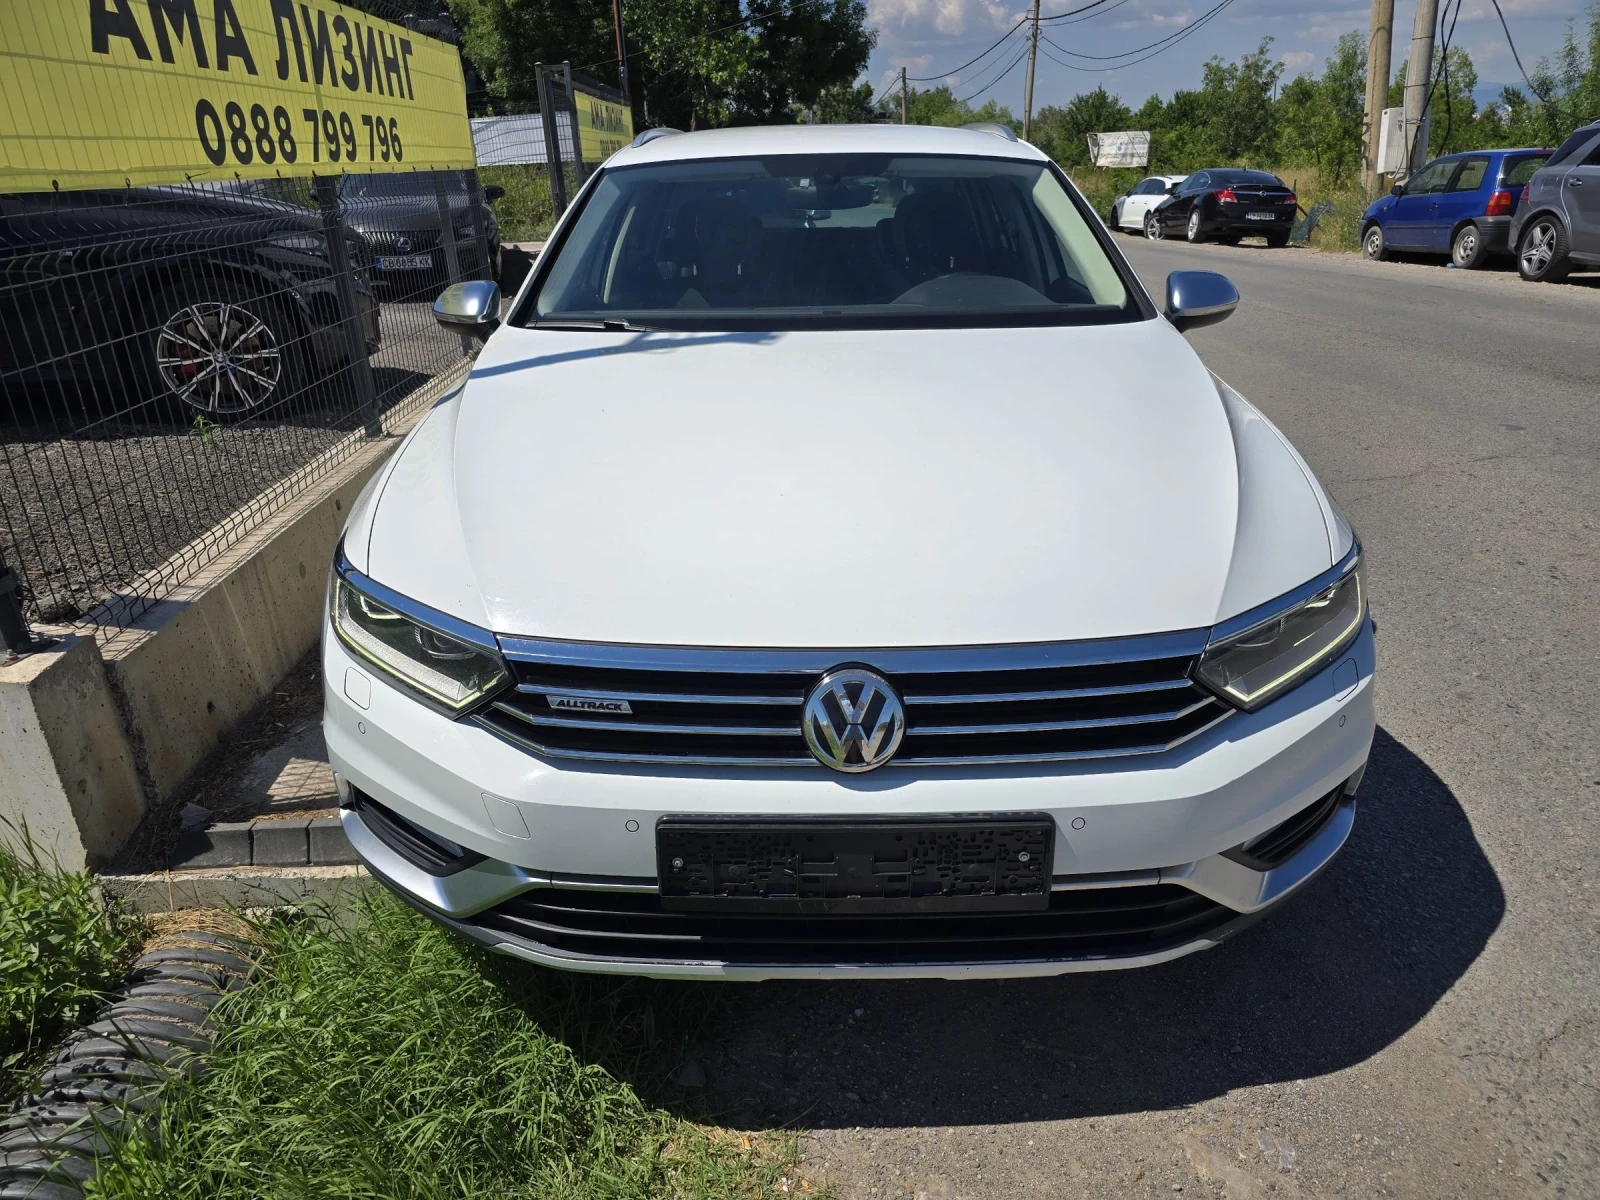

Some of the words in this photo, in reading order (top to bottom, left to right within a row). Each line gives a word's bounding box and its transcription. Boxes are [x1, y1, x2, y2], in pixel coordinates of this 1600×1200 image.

[89, 0, 259, 76] АМА
[270, 0, 415, 101] ЛИЗИНГ
[195, 98, 298, 167] 0888
[302, 108, 357, 163] 799
[361, 114, 403, 163] 796
[556, 699, 623, 712] ALLTRACK
